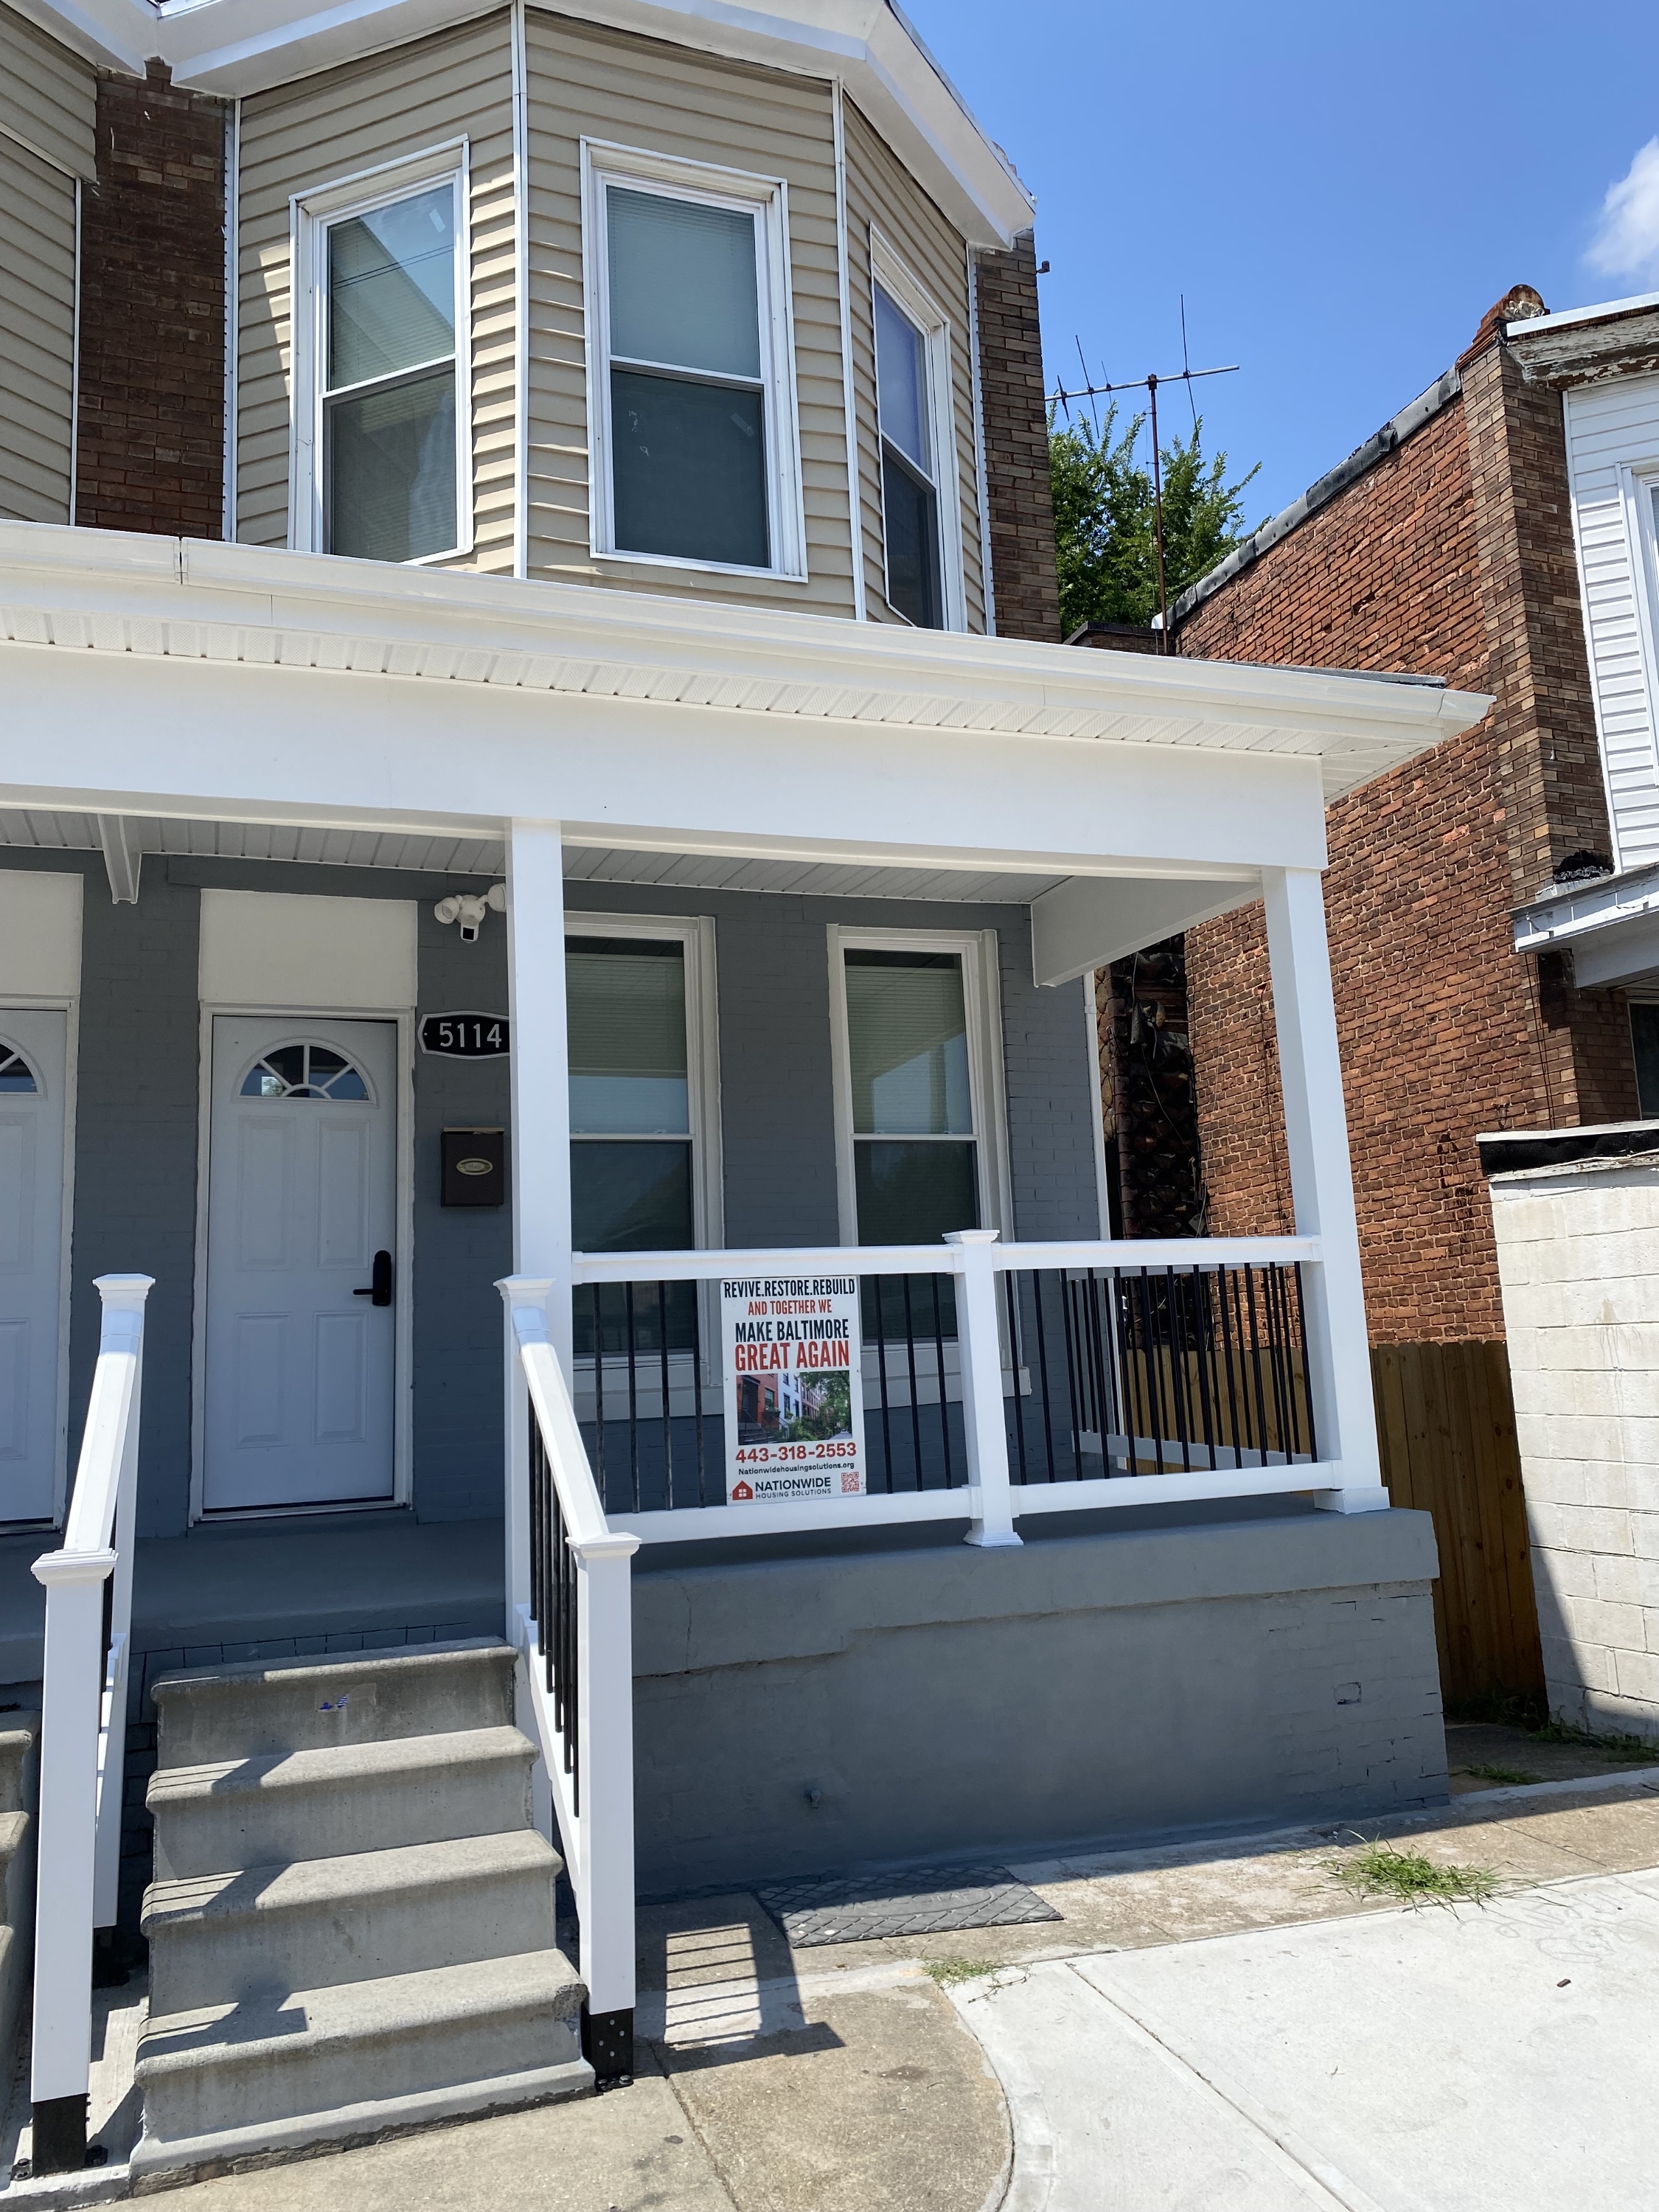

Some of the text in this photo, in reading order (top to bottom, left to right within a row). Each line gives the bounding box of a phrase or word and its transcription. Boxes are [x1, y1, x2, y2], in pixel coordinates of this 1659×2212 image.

[439, 1023, 502, 1048] 5114
[724, 1279, 855, 1298] REVIVE.RESTORE.REBUILD
[748, 1299, 832, 1315] AND TOGETHER WE
[736, 1319, 849, 1342] MAKE BALTIMORE
[735, 1340, 849, 1371] GREAT AGAIN
[736, 1442, 856, 1463] 443-318-2553
[739, 1463, 855, 1475] Nationwidehousingsolutions.org
[755, 1477, 831, 1491] NATIONWIDE
[791, 1488, 831, 1497] SOLUTIONS
